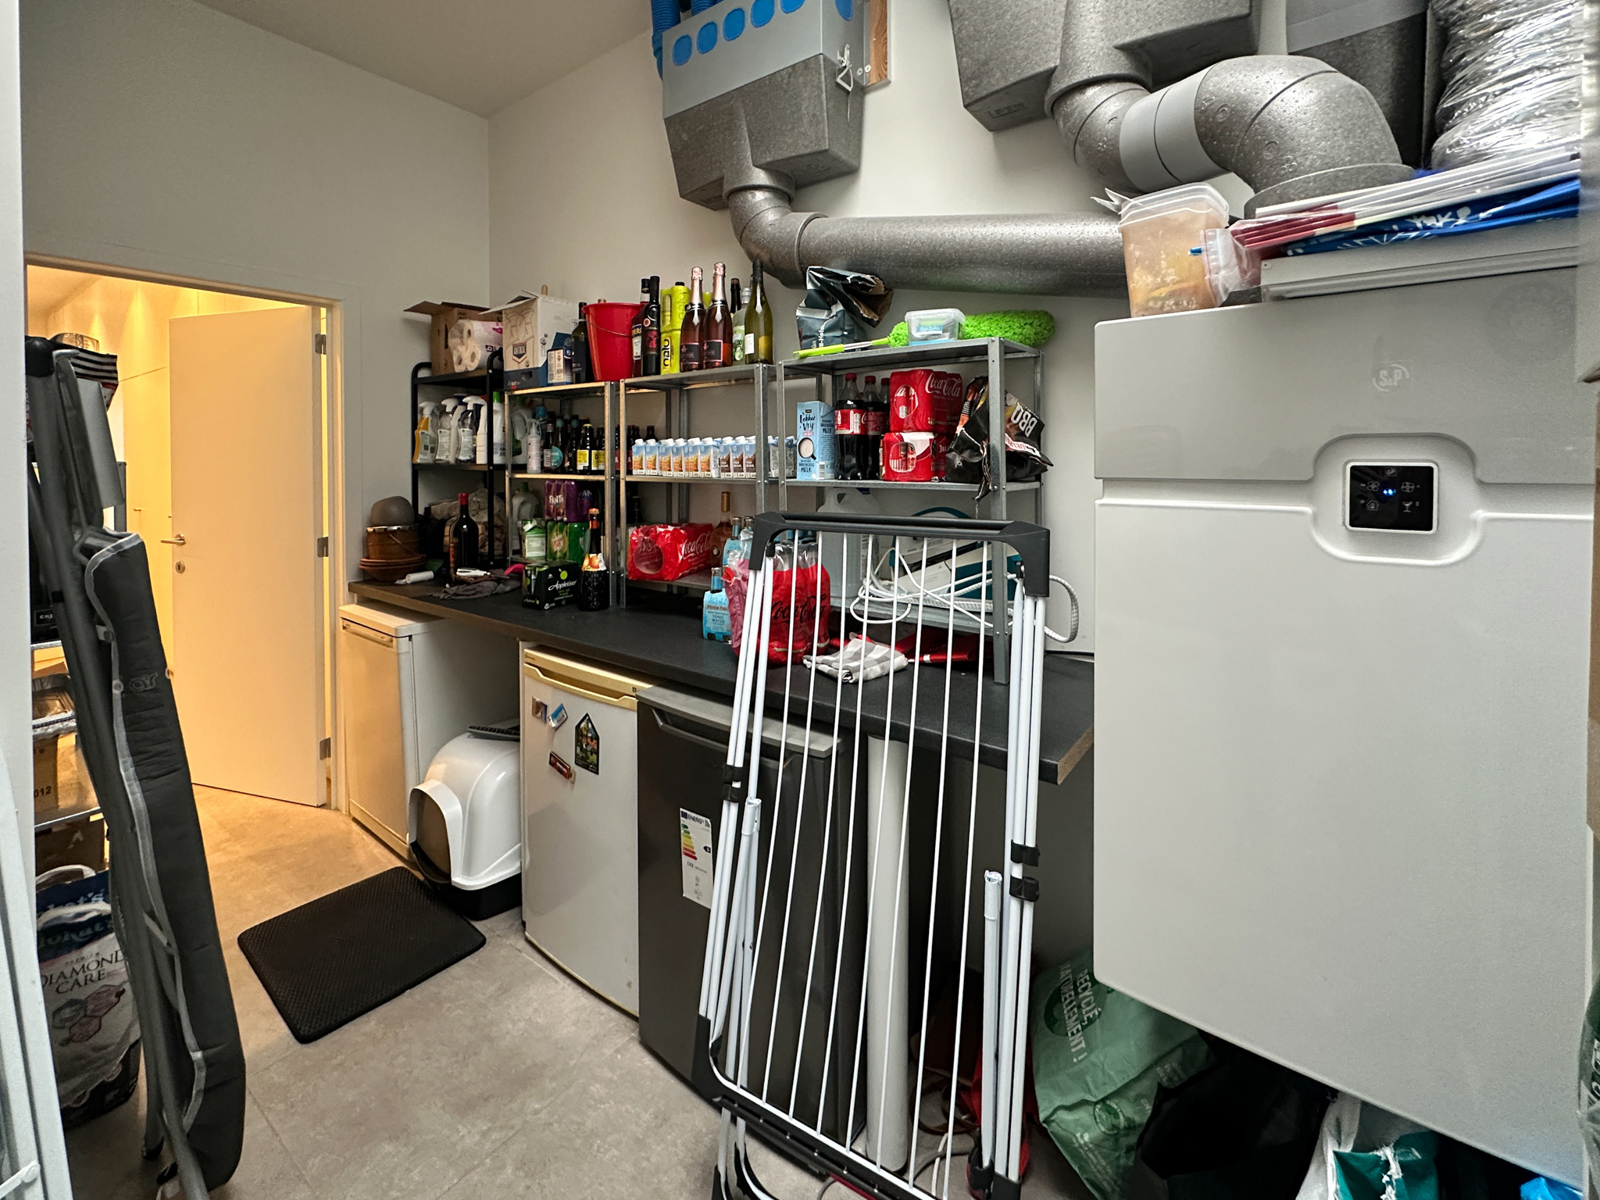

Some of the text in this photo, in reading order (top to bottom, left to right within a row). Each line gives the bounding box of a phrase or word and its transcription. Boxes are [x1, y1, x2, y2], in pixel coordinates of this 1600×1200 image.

[661, 339, 670, 367] nalu
[925, 371, 962, 398] Coca-Cola
[1011, 401, 1039, 438] BBQ
[548, 580, 577, 591] Appletiser
[55, 968, 106, 994] CARE
[1058, 960, 1087, 1053] NATURELLEMENT
[1076, 967, 1102, 1026] RECYCLÉ,
